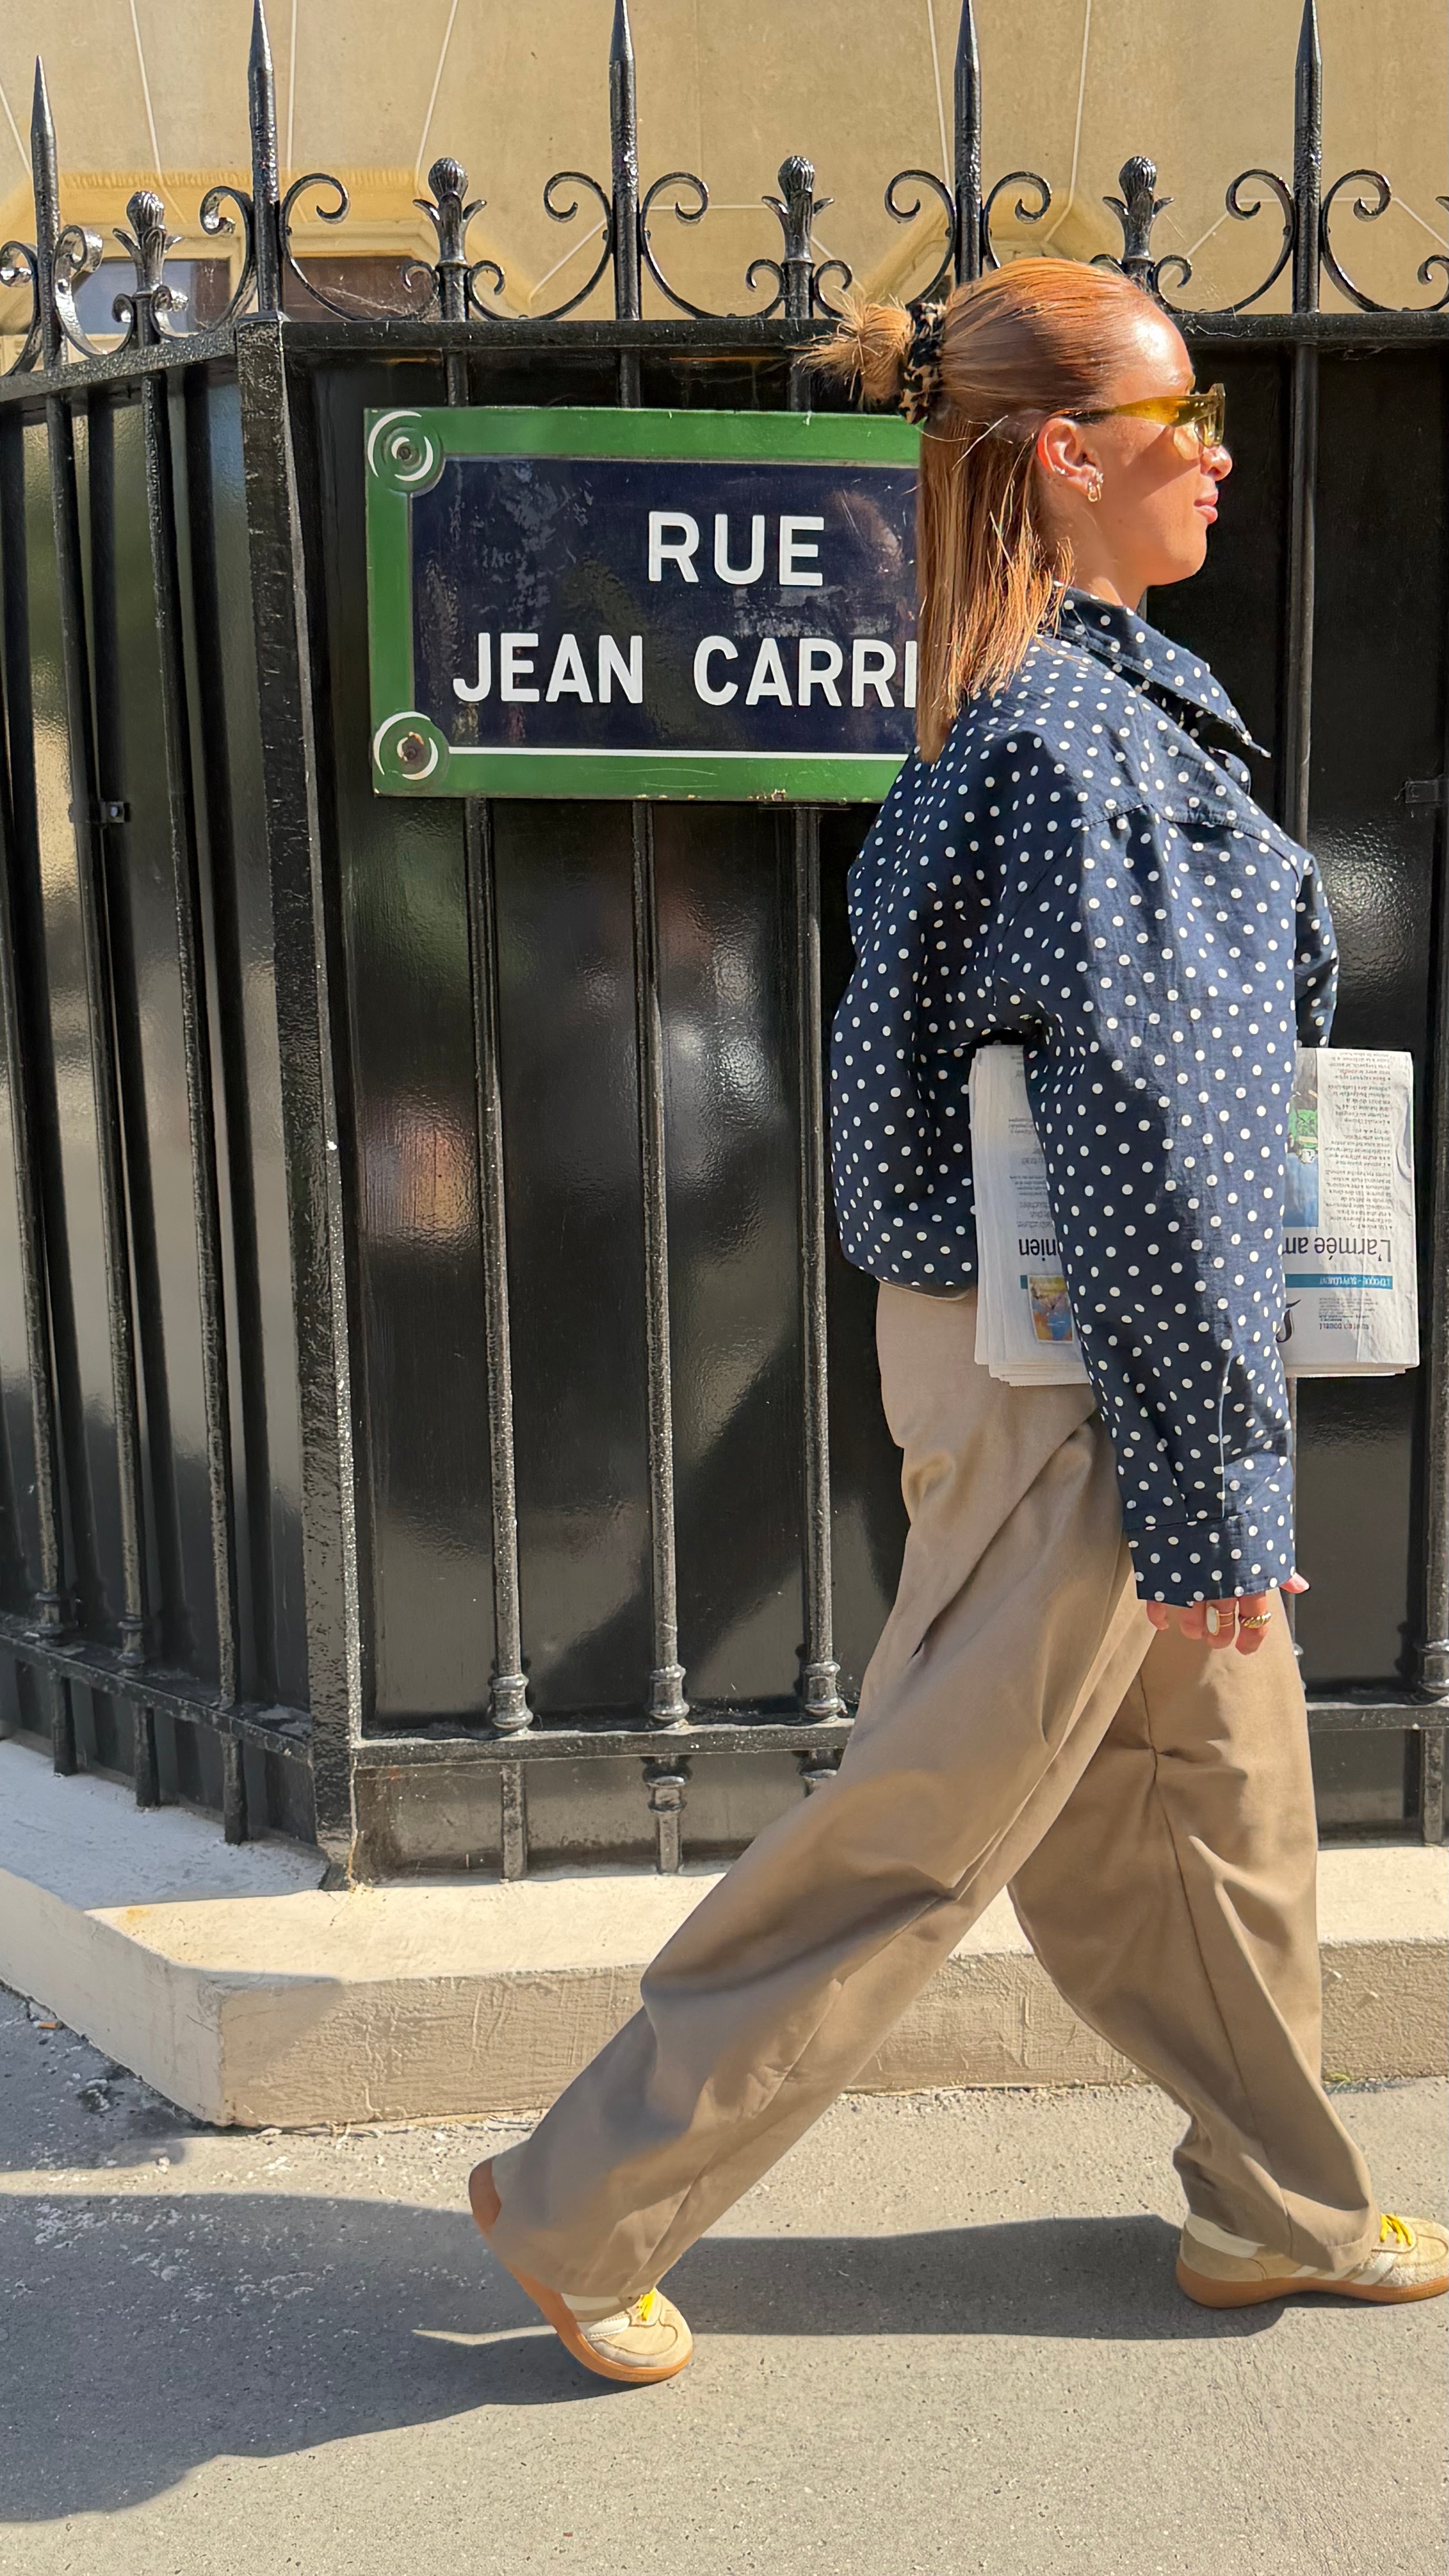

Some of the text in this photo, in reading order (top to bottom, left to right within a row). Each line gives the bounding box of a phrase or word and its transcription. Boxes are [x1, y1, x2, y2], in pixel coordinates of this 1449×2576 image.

[648, 511, 825, 586] RUE
[452, 632, 917, 708] JEAN CARRI
[1019, 1239, 1059, 1261] nien
[1314, 1237, 1392, 1263] L'armée
